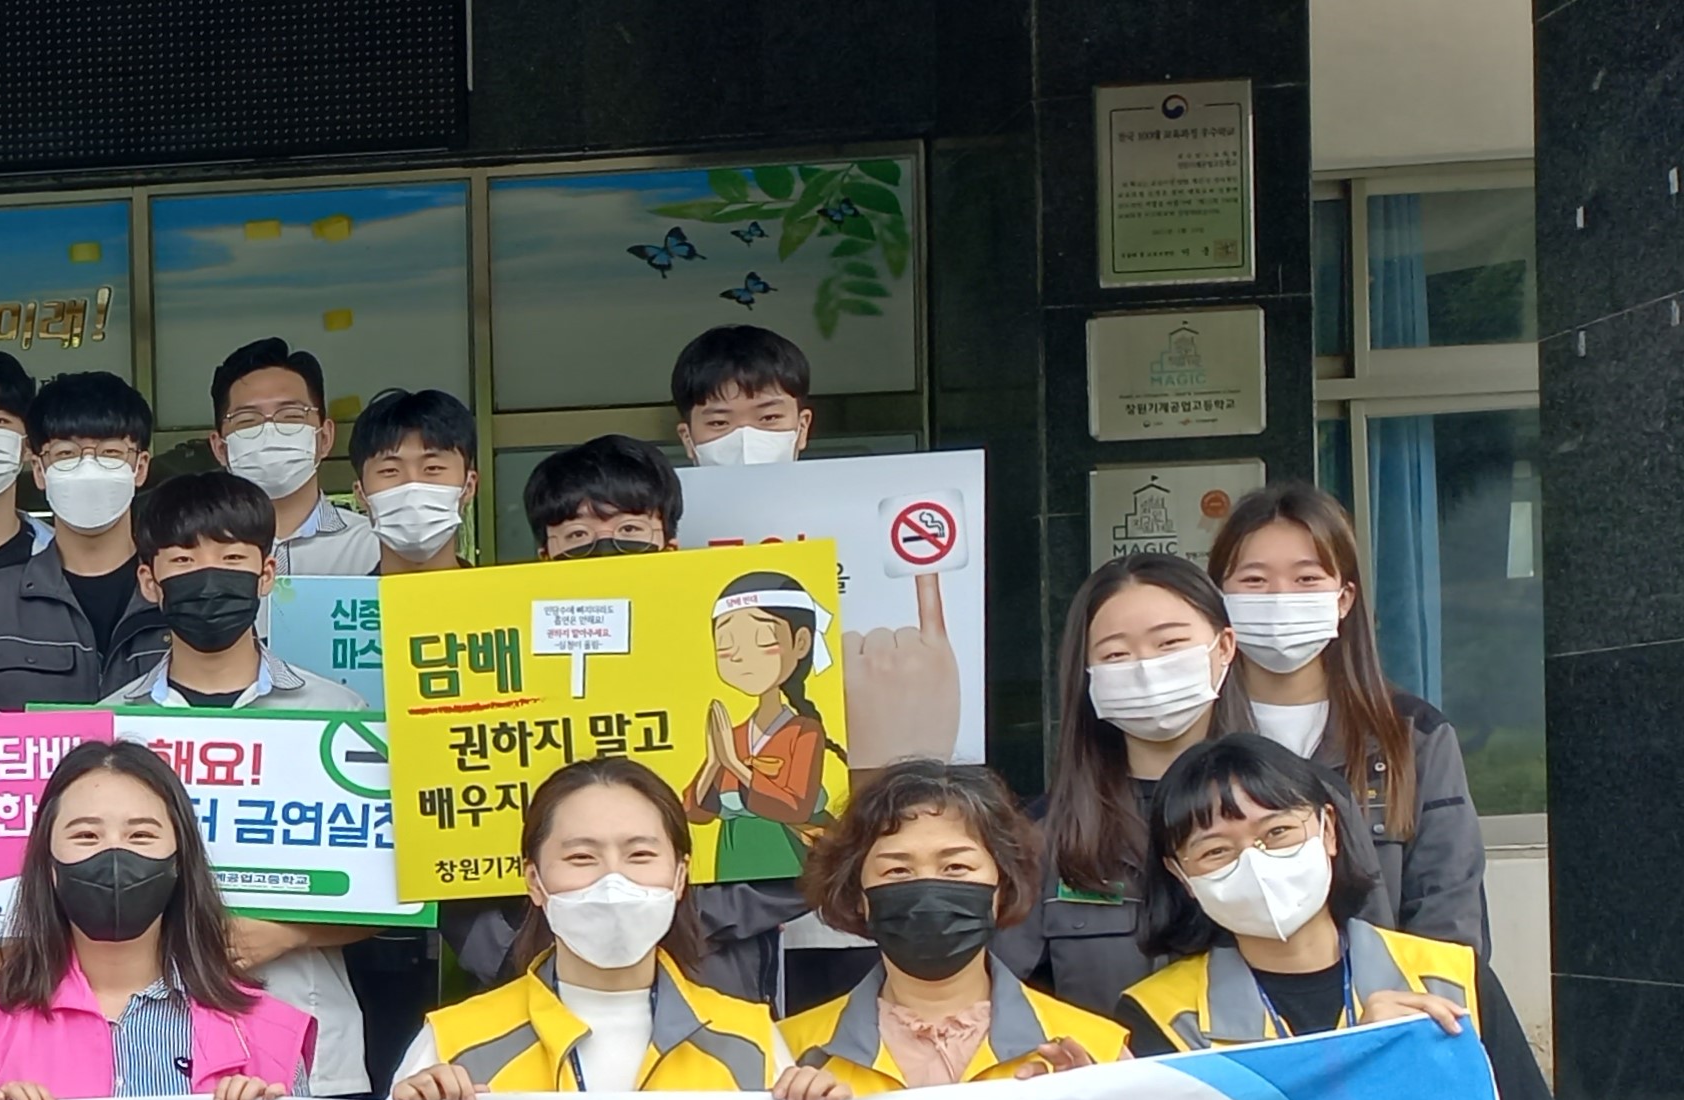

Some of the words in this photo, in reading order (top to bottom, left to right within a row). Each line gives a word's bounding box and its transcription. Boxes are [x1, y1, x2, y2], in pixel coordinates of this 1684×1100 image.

[409, 627, 523, 699] 담배
[449, 717, 574, 772] 권하지
[589, 710, 674, 759] 말고
[419, 782, 531, 829] 배우지
